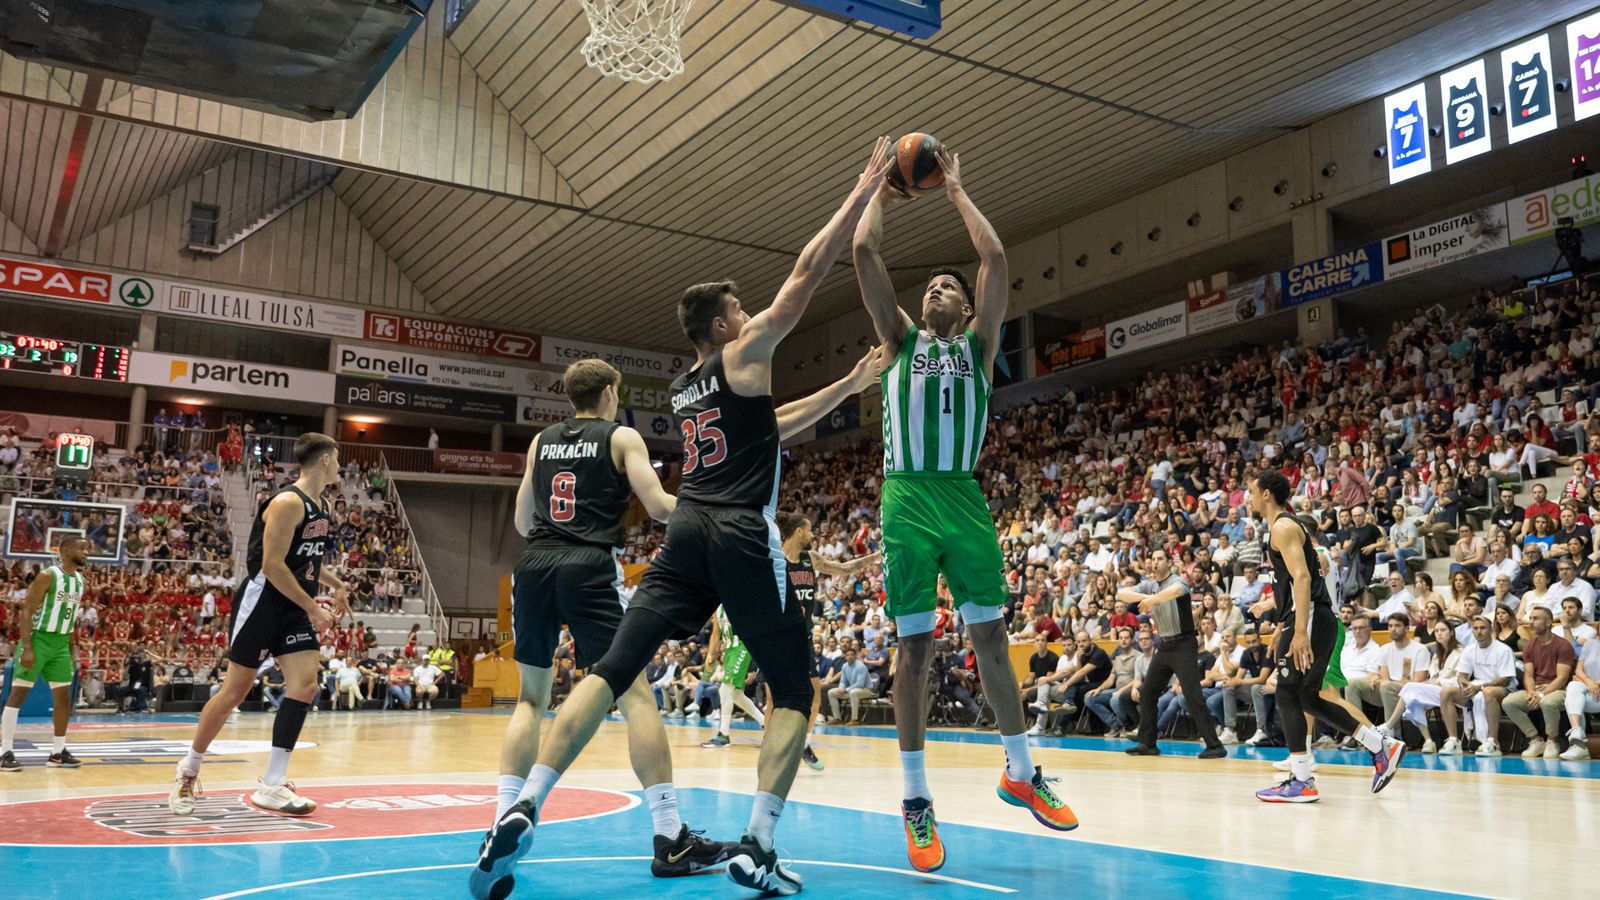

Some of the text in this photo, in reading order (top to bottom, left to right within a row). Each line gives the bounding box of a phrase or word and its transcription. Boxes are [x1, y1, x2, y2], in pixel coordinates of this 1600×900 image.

[1519, 78, 1537, 106] 7
[1456, 102, 1475, 128] 9
[1400, 126, 1414, 148] 7
[1413, 215, 1476, 241] La DIGITAL
[1414, 234, 1465, 257] impser
[1288, 248, 1369, 282] CALSINA
[0, 264, 109, 298] PAR
[201, 293, 251, 319] LLEAL
[260, 300, 315, 328] TULSÀ
[403, 318, 495, 339] EQUIPACIONS
[1129, 313, 1183, 336] Globalimar
[18, 336, 58, 351] 07:40
[409, 329, 489, 348] ESPORTIVES
[32, 350, 41, 361] 2
[64, 351, 77, 362] 19
[341, 350, 428, 377] Panella
[912, 353, 971, 372] Sevilla
[63, 364, 72, 376] 0
[191, 362, 289, 388] parlem
[439, 362, 505, 378] www.panella.cat
[671, 375, 720, 414] SOROLLA
[942, 387, 952, 414] 1
[61, 435, 91, 446] 07:40
[540, 439, 598, 460] PRKAČIN
[681, 407, 728, 475] 35
[69, 445, 88, 463] 17
[484, 455, 495, 463] tu
[549, 471, 576, 522] 8
